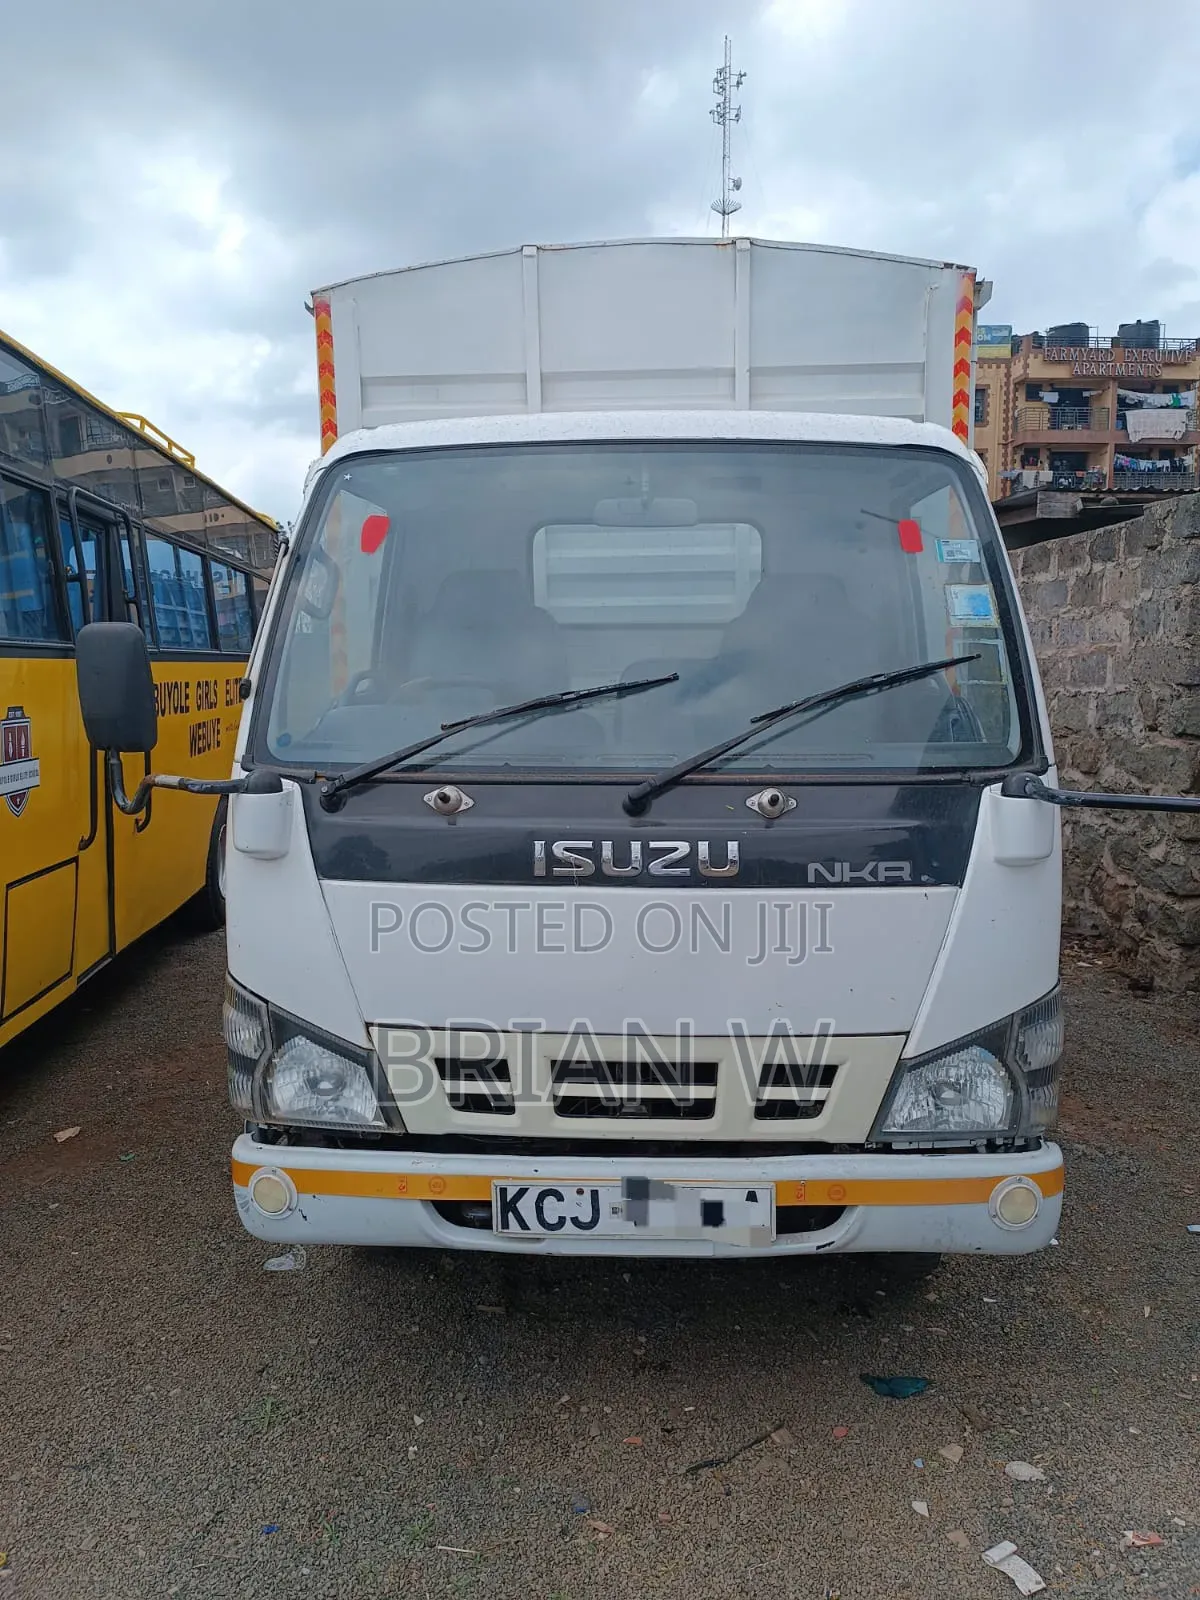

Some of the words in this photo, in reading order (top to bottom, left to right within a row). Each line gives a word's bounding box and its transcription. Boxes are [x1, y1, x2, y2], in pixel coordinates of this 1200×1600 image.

[1044, 348, 1115, 361] FARMYARD
[1124, 349, 1193, 363] EXECUTIVE
[1072, 362, 1162, 377] APARTMENTS
[196, 680, 217, 712] GIRLS
[189, 718, 220, 758] WEBUYE
[533, 840, 740, 878] ISUZU
[807, 861, 913, 883] NKR
[500, 1187, 601, 1232] KCJ
